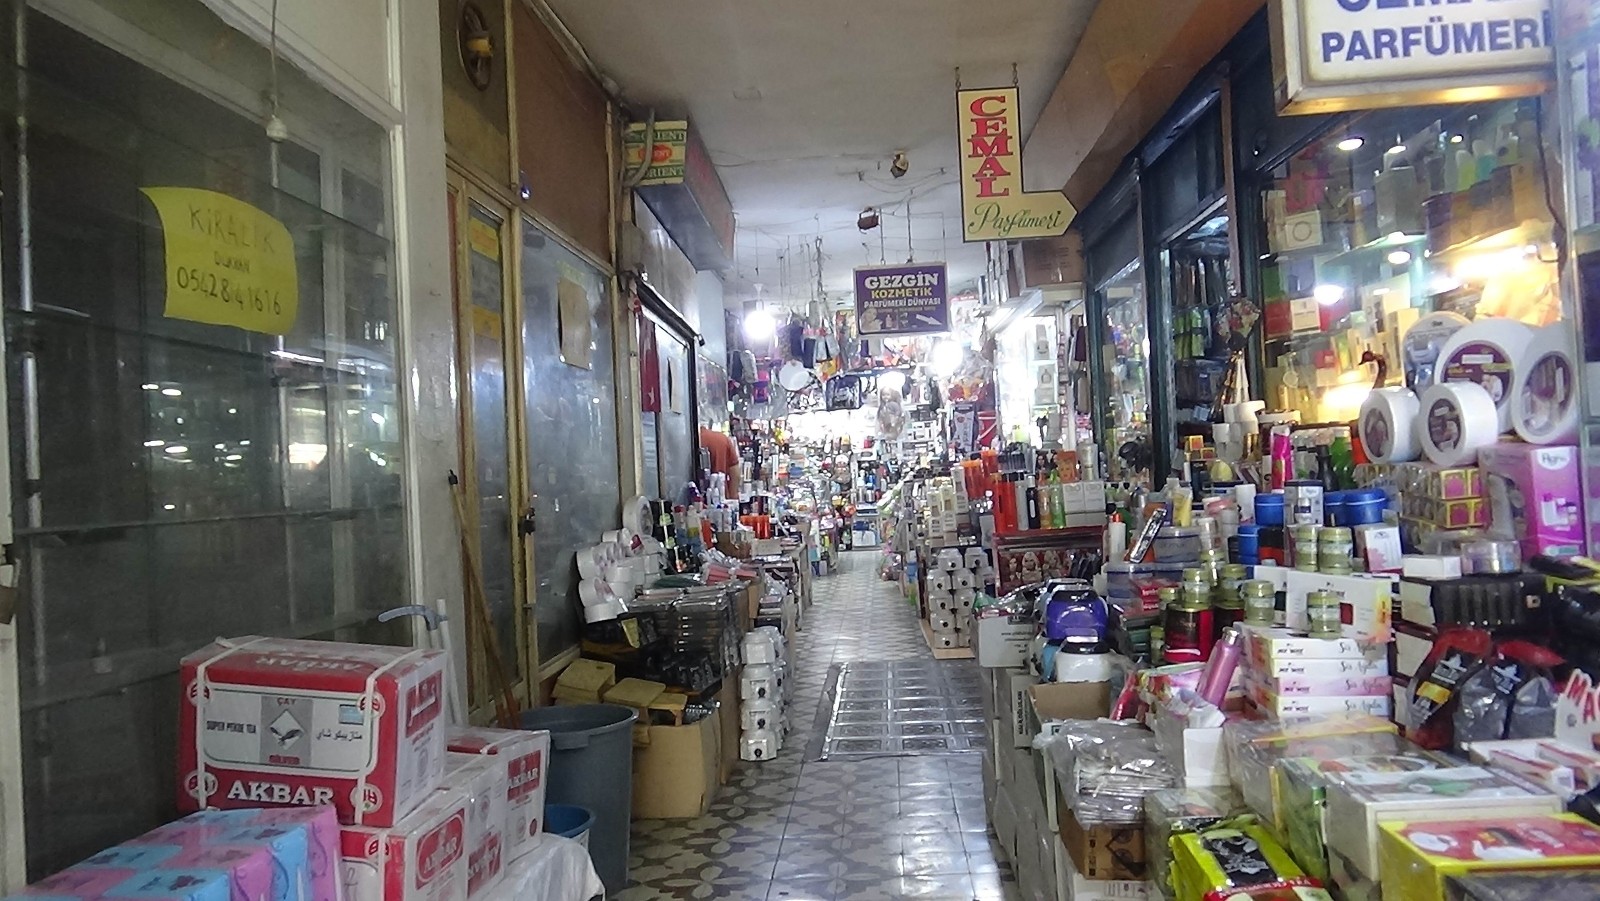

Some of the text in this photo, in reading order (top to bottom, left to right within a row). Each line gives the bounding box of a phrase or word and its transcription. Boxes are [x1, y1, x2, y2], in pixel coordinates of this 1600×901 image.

[641, 130, 685, 141] IENT
[967, 95, 1014, 198] CEMAL
[647, 165, 685, 178] RIENT
[968, 202, 1065, 236] Parfümeri
[864, 271, 939, 290] GEZGİN
[907, 297, 941, 308] DÜNYASI
[226, 779, 334, 806] AKBAR
